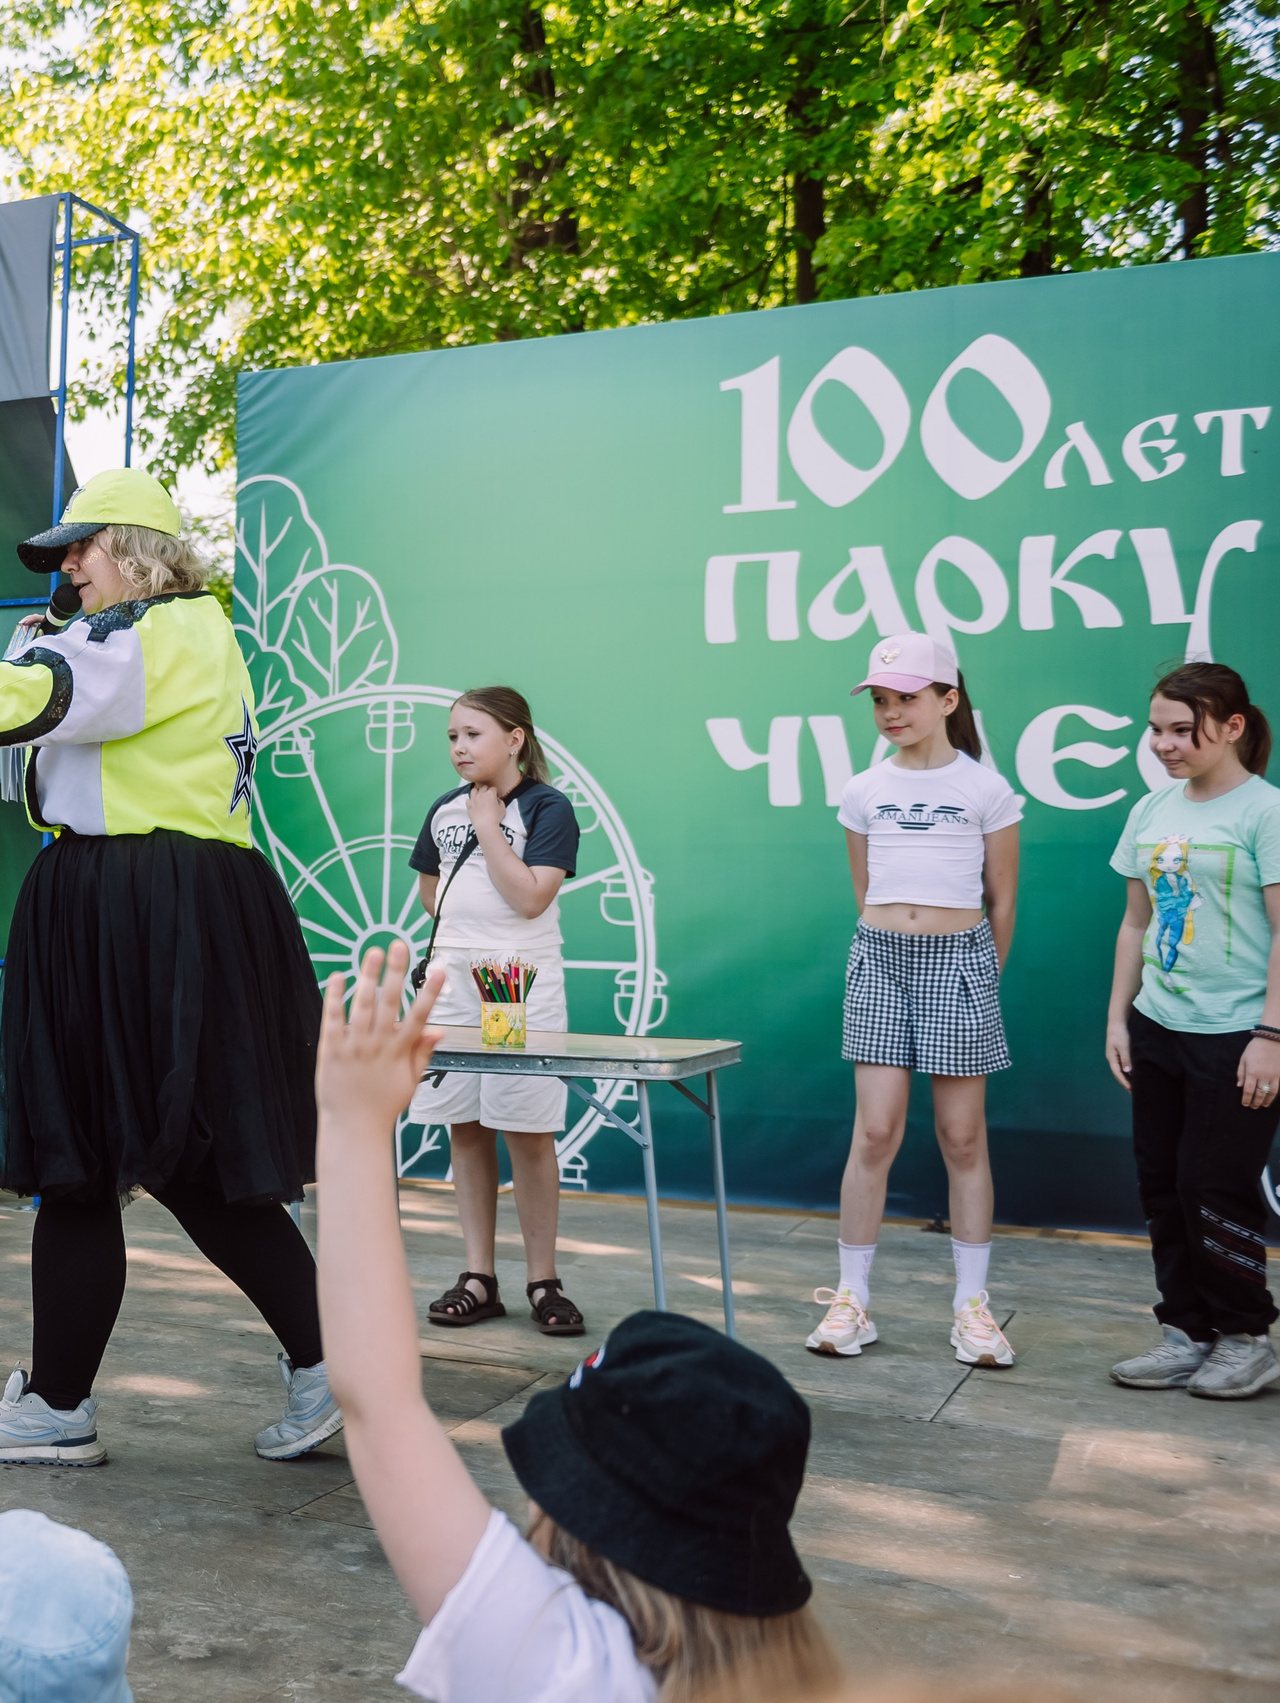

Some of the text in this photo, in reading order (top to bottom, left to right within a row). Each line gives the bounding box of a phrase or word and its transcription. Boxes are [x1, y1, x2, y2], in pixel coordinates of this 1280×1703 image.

[719, 333, 1052, 514] 100
[704, 519, 1264, 664] ПАРКУ
[925, 812, 969, 824] JEANS
